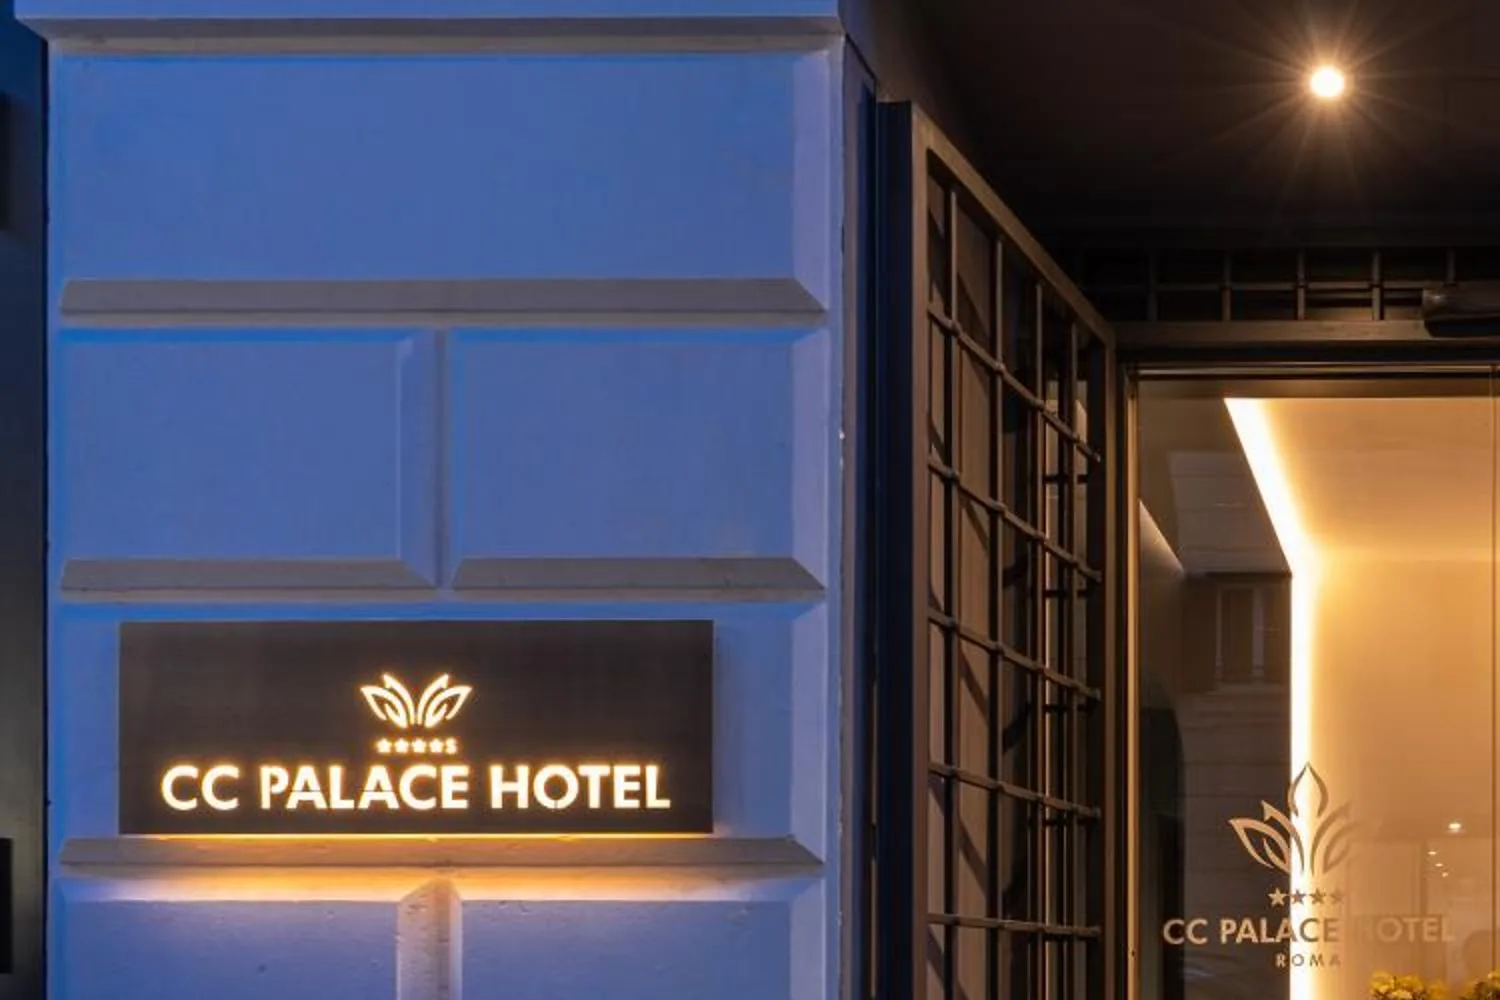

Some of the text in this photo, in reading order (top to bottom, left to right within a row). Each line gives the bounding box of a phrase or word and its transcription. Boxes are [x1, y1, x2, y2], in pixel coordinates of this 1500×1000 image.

[161, 765, 671, 810] CC PALACE HOTEL
[1163, 919, 1208, 945] CC
[1219, 917, 1341, 943] PALACE
[1275, 953, 1342, 968] ROMA
